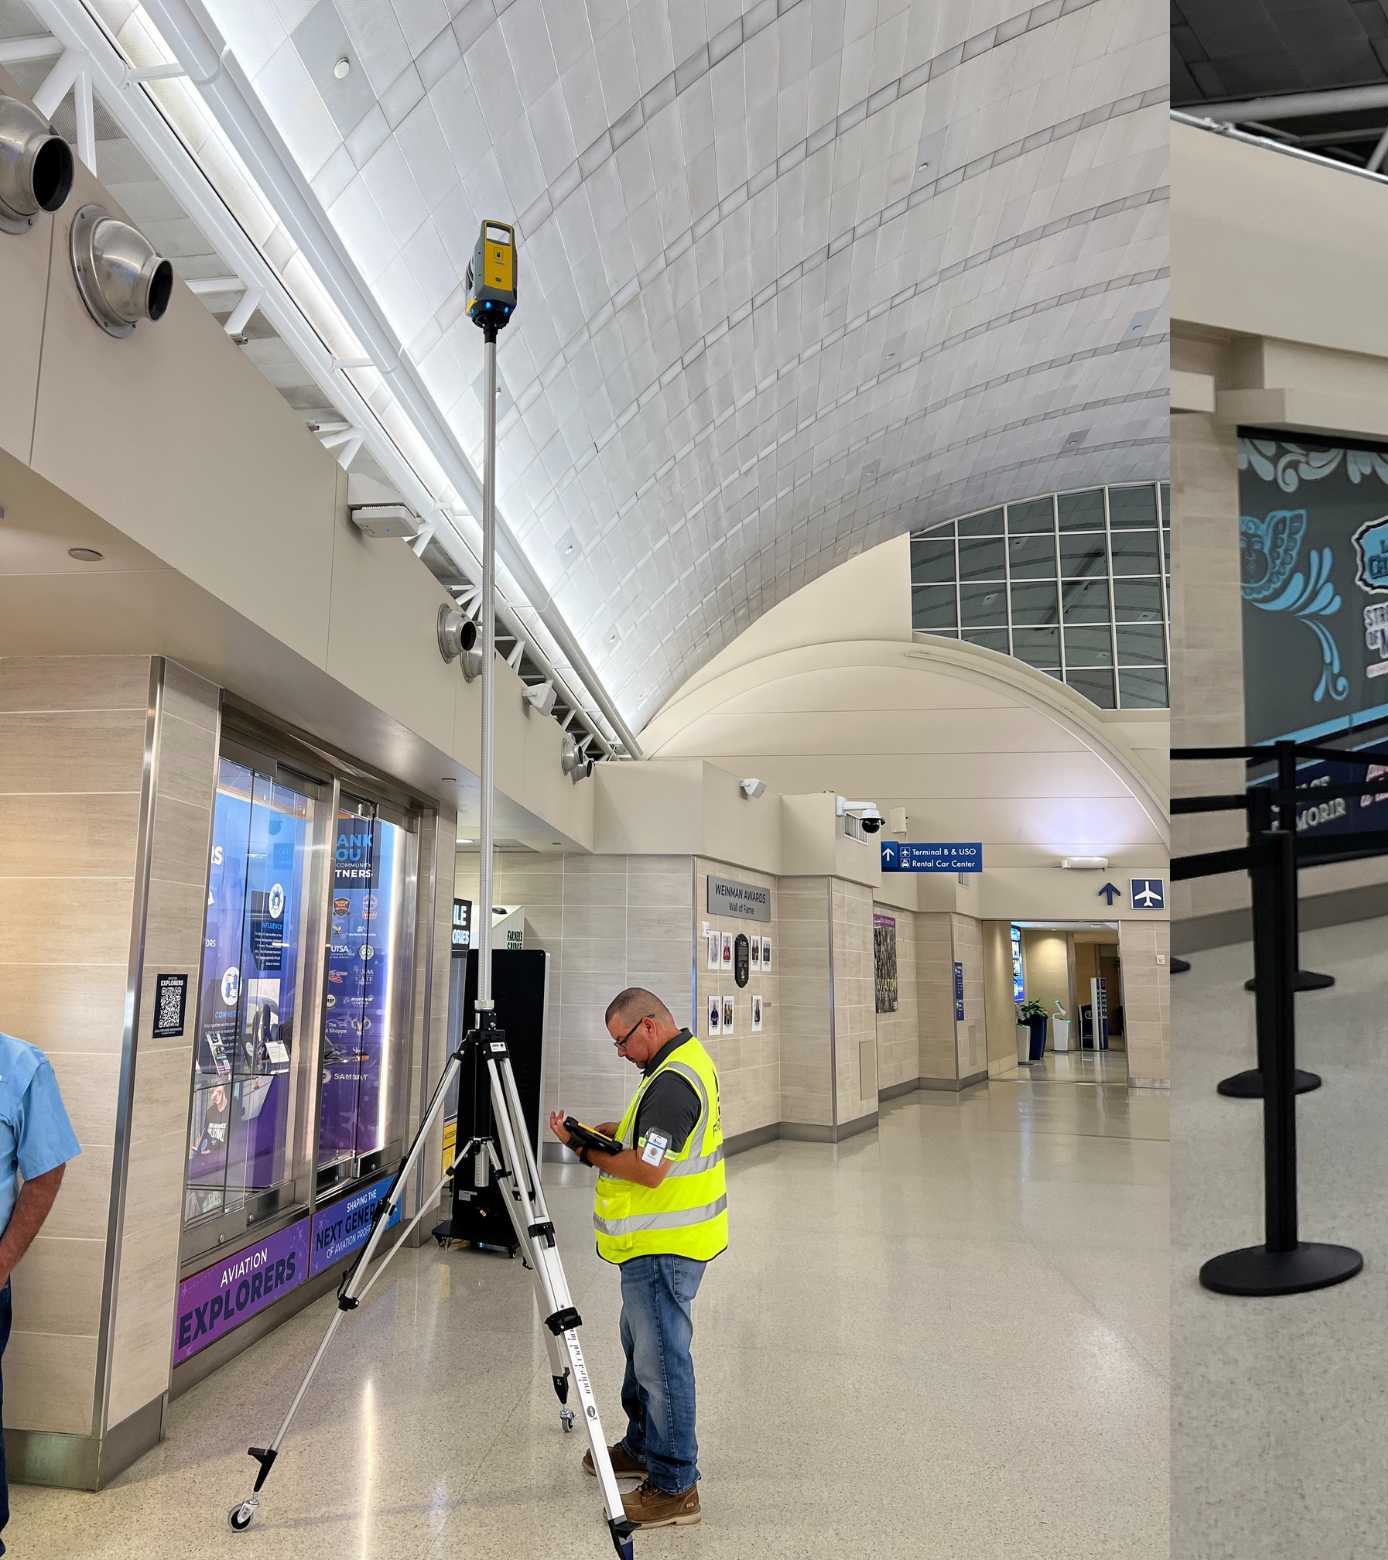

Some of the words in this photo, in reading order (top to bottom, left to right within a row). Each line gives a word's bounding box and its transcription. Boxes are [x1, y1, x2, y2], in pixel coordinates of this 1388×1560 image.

[912, 848, 941, 856] Terminal
[912, 860, 934, 868] Rental
[936, 860, 949, 868] Car
[951, 860, 975, 868] Center
[715, 884, 743, 900] WEINMAN
[744, 889, 767, 904] AWARDS
[729, 902, 738, 913] Wall
[346, 1194, 368, 1212] SHAPING
[368, 1189, 377, 1201] THE
[316, 1220, 343, 1252] NEXT
[326, 1246, 335, 1259] OF
[335, 1234, 357, 1254] AVIATION
[220, 1248, 268, 1288] AVIATION
[178, 1251, 296, 1349] EXPLORERS
